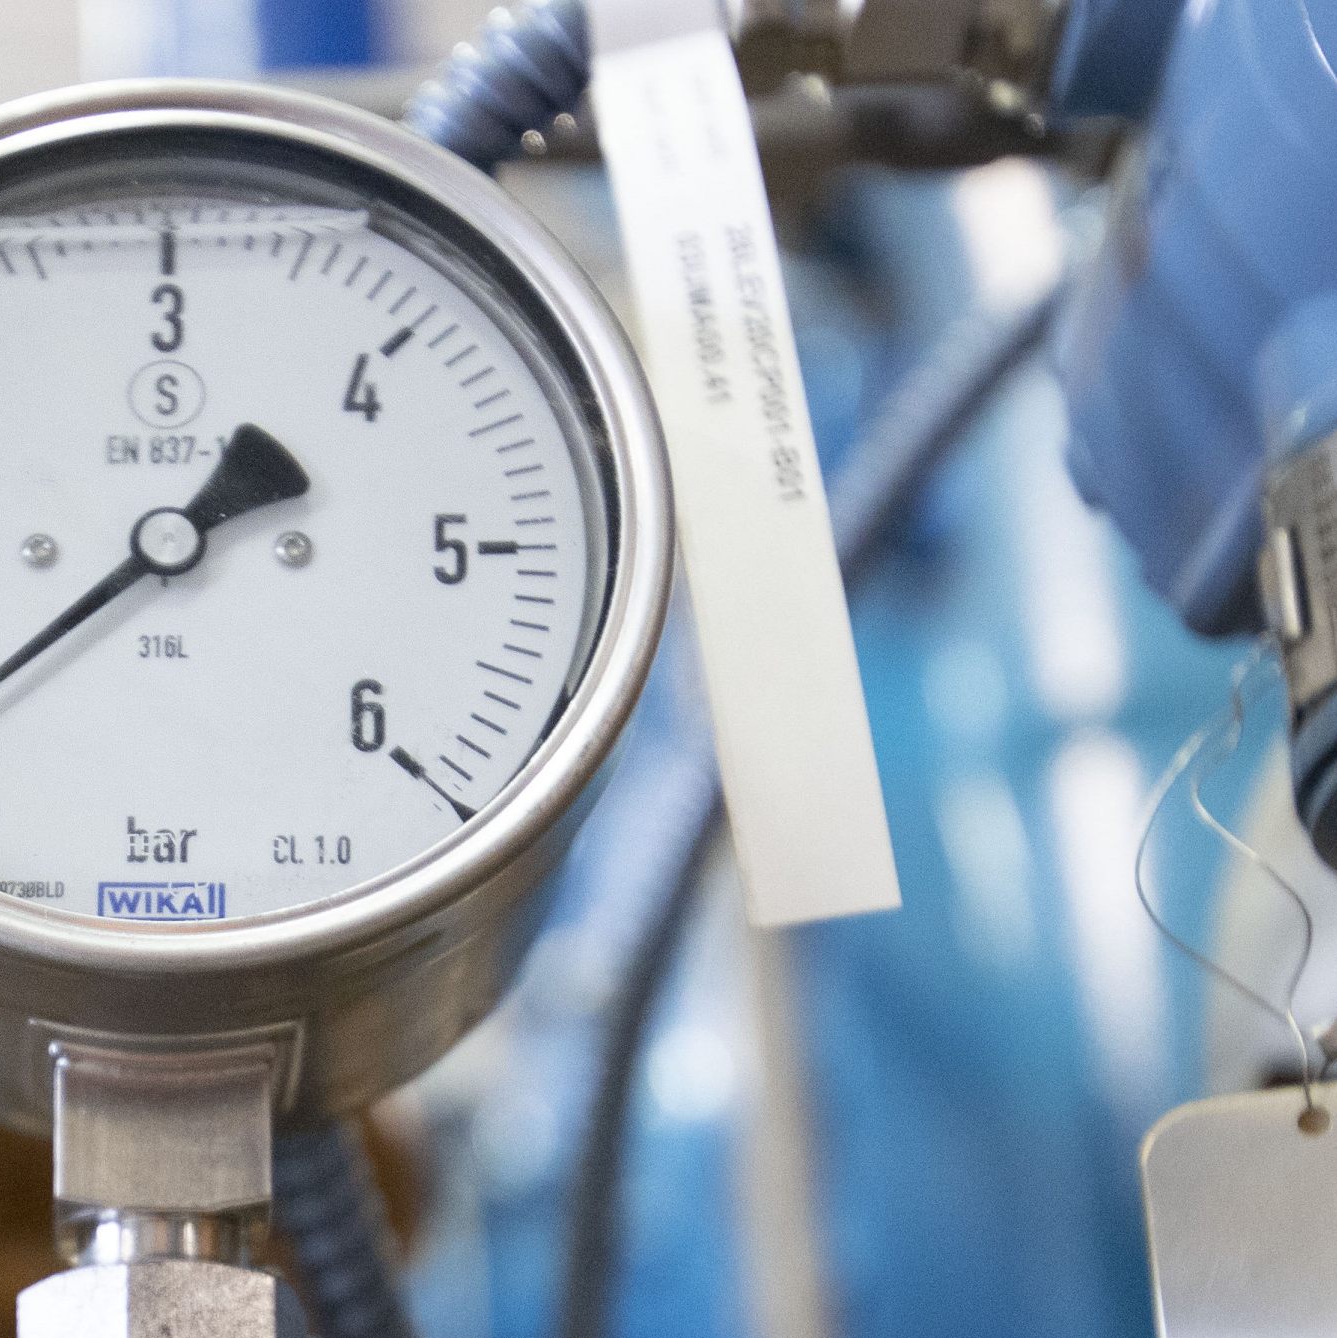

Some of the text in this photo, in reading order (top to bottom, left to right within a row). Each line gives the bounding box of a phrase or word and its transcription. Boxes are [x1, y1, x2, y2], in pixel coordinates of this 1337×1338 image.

[149, 282, 186, 355] 3
[342, 354, 382, 424] 4
[105, 435, 141, 465] EN
[433, 514, 469, 587] 5
[138, 634, 190, 660] 316L
[349, 679, 388, 753] 6
[125, 815, 198, 865] bar
[314, 834, 352, 866] 1.0
